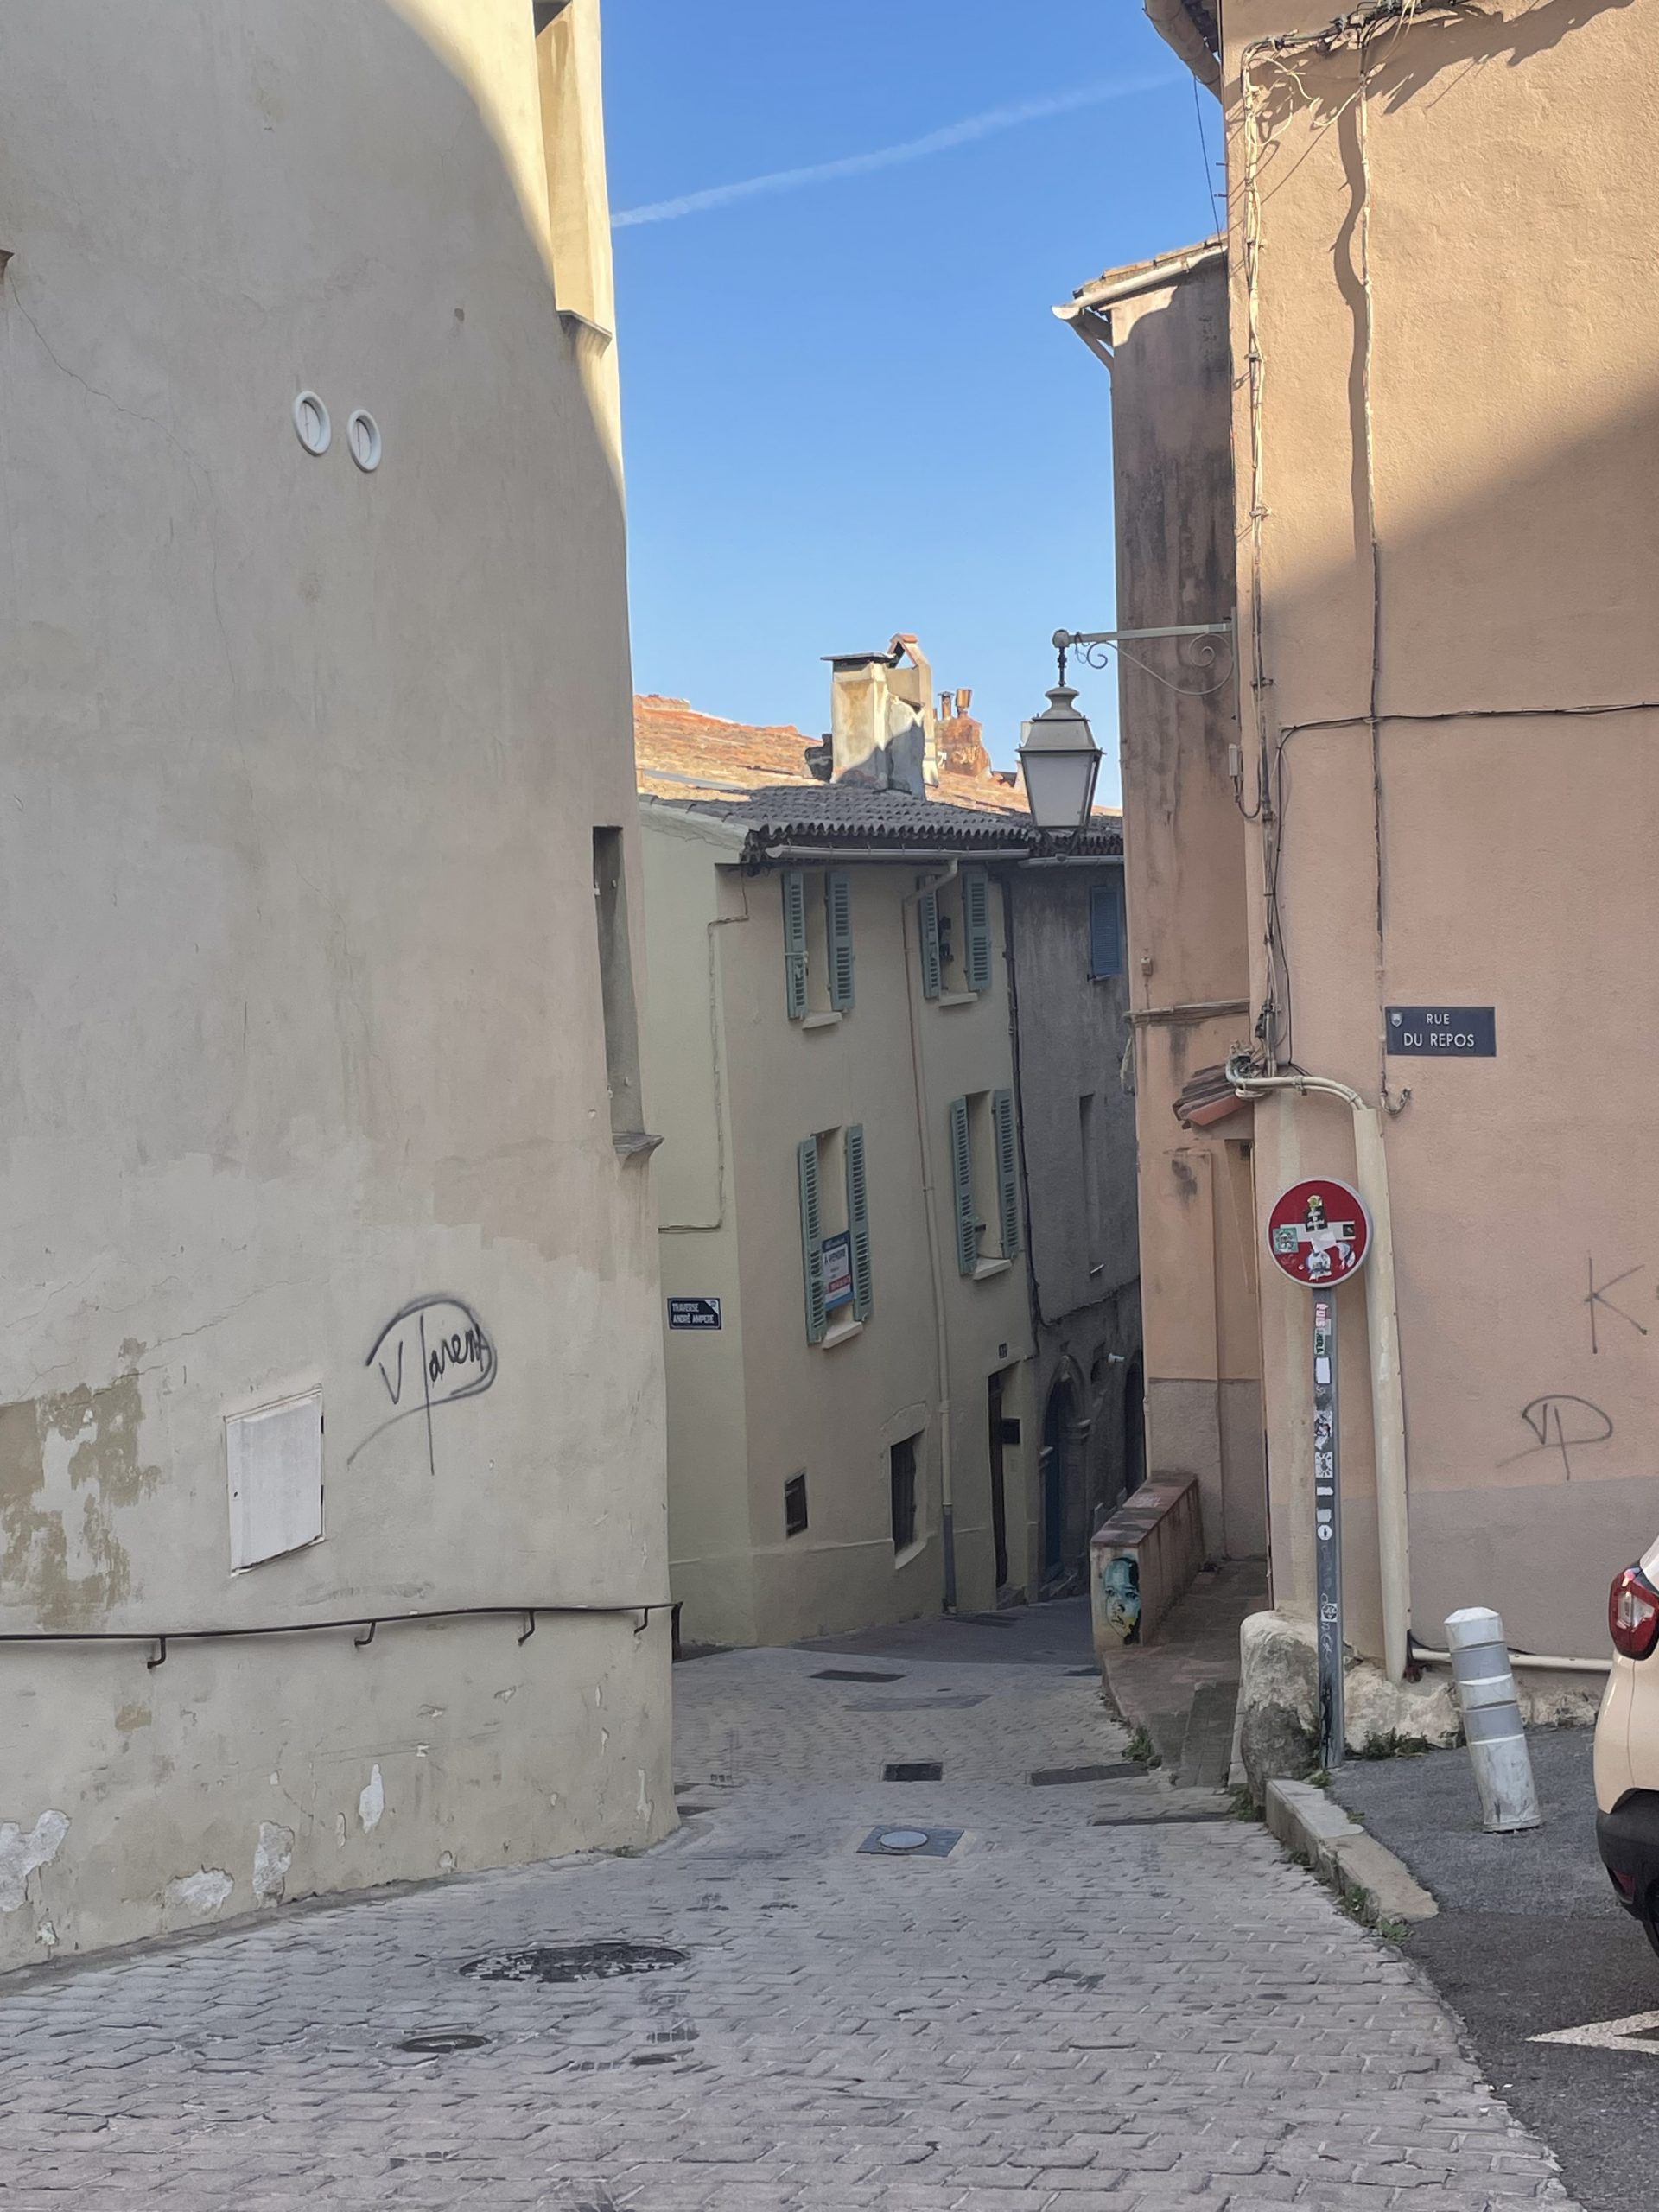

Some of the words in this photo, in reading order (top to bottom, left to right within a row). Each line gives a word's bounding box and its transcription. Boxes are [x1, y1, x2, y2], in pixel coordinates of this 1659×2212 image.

[1427, 1014, 1450, 1025] RUE
[1403, 1033, 1422, 1046] DU
[1430, 1033, 1475, 1047] REPOS
[672, 1303, 699, 1312] TRAVERSE
[673, 1313, 691, 1323] ANDRÉ
